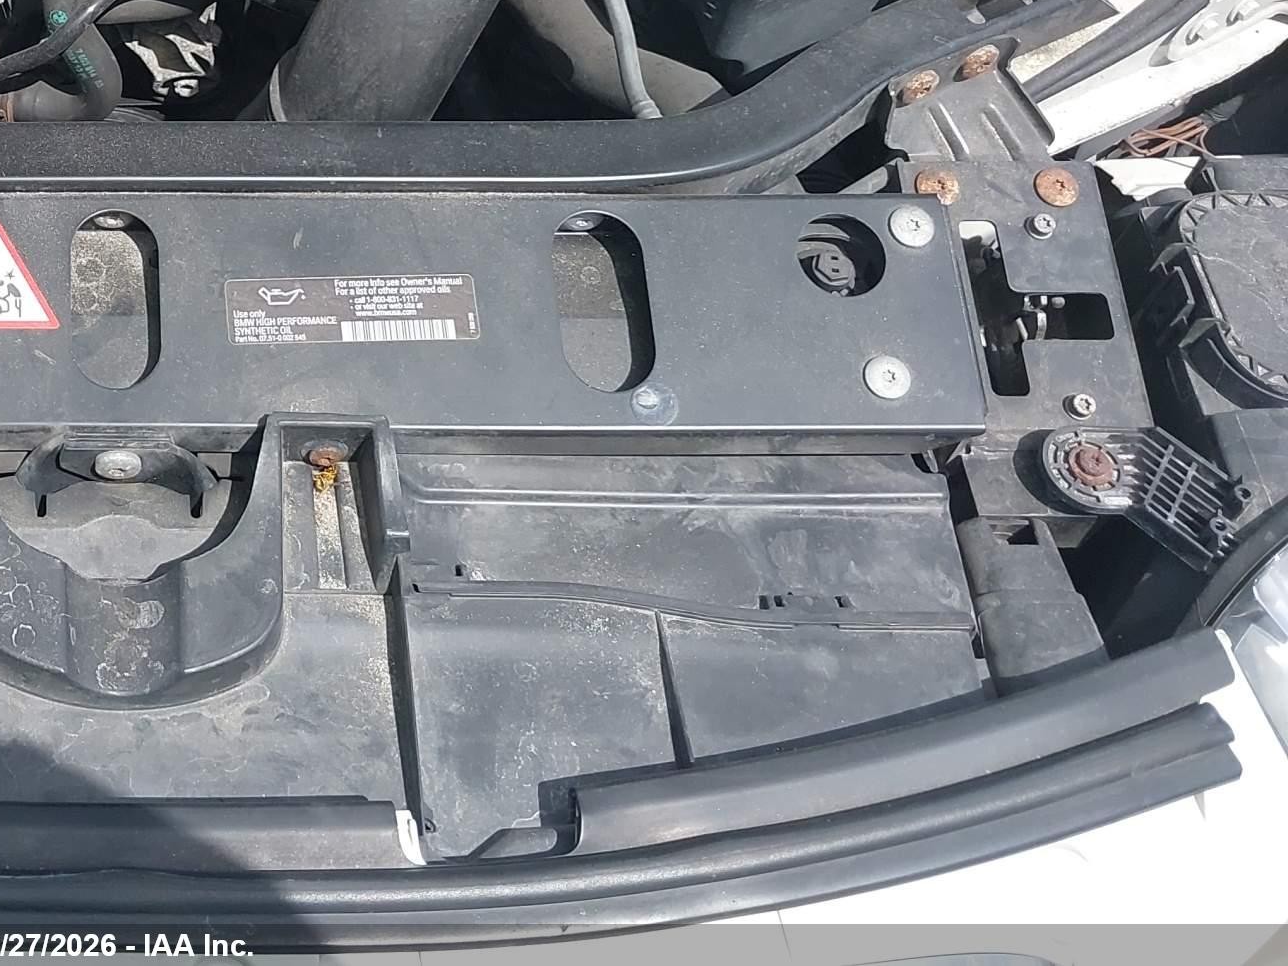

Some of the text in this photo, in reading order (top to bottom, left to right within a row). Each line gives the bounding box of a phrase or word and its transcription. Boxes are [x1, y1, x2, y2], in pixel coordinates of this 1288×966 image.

[334, 279, 347, 287] For
[401, 277, 432, 286] Owner's
[335, 287, 348, 296] For
[356, 287, 368, 295] list
[368, 286, 377, 295] of
[377, 286, 399, 294] other
[399, 285, 436, 295] approved
[233, 308, 266, 320] Use only
[233, 315, 338, 328] BMW HIGH PERFORMANCE
[234, 325, 293, 336] SYNTHETIC OIL
